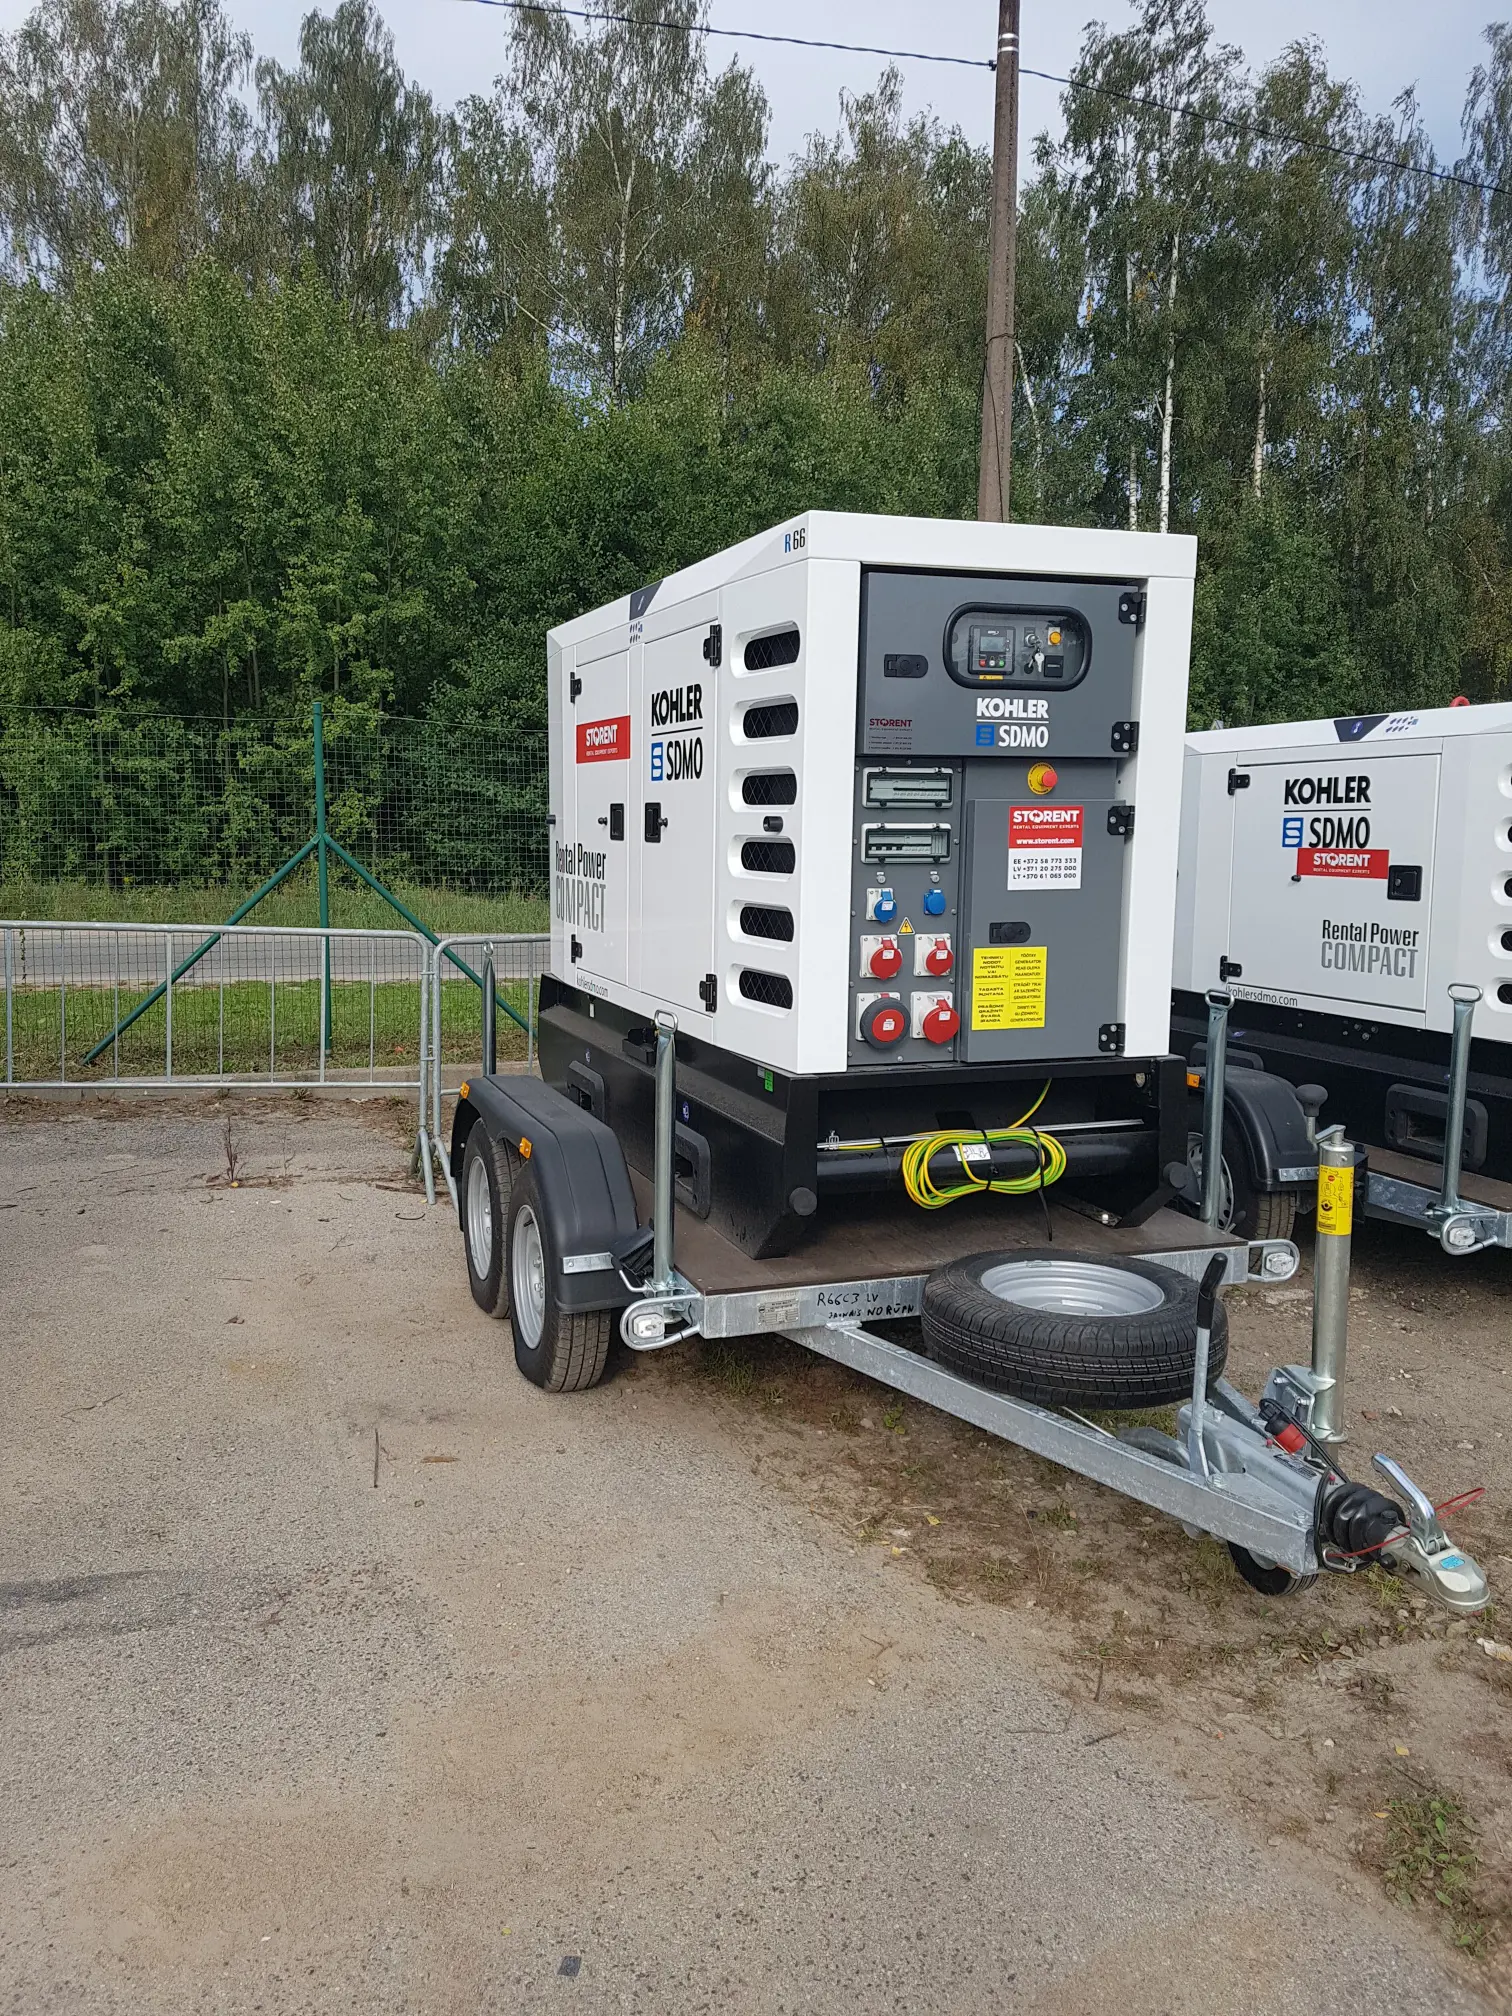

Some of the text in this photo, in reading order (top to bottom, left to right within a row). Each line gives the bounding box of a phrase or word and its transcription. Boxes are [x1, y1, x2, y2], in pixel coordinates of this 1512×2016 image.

[784, 528, 806, 554] R 66
[651, 683, 703, 727] KOHLER
[976, 697, 1049, 719] KOHLER
[869, 718, 913, 727] STORENT
[585, 724, 618, 747] STORENT
[998, 724, 1049, 748] SDMO
[666, 736, 703, 781] SDMO
[1284, 775, 1372, 805] KOHLER
[1013, 810, 1080, 823] STORENT
[1016, 837, 1075, 845] www.storent.com
[1308, 816, 1371, 849] SDMO
[555, 840, 607, 881] Rental Power
[1313, 852, 1371, 867] STORENT
[555, 875, 607, 934] COMPACT
[1322, 919, 1420, 947] Rental Power
[1321, 942, 1419, 979] COMPACT
[1227, 985, 1298, 1007] kohlersdmo.com
[866, 1292, 879, 1303] LV
